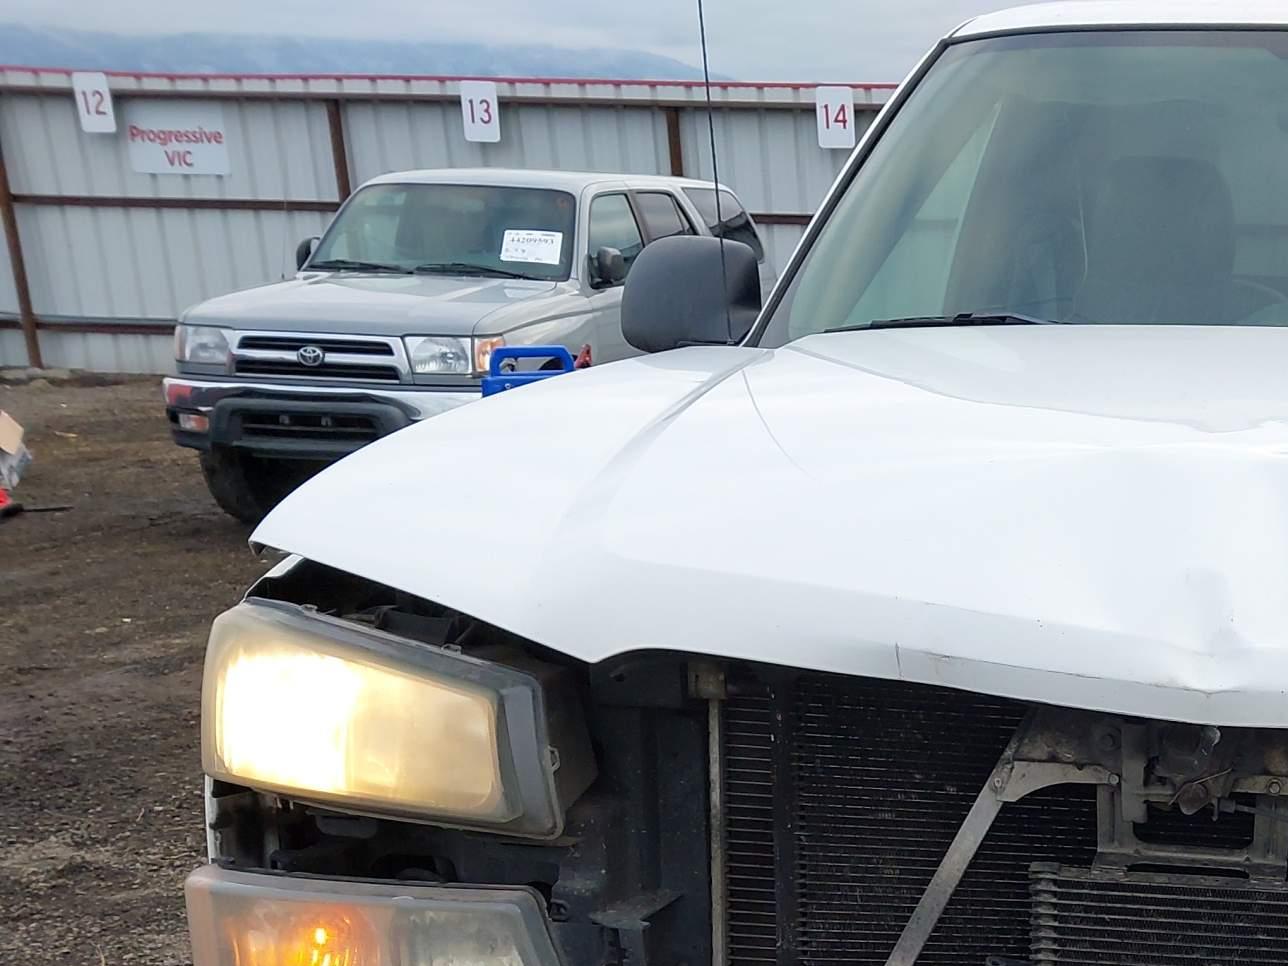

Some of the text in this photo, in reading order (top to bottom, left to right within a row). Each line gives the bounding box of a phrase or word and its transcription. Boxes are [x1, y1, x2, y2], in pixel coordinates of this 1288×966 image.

[81, 90, 107, 116] 12
[468, 98, 492, 124] 13
[823, 103, 848, 130] 14
[128, 124, 224, 146] Progressive
[164, 150, 194, 168] VIC
